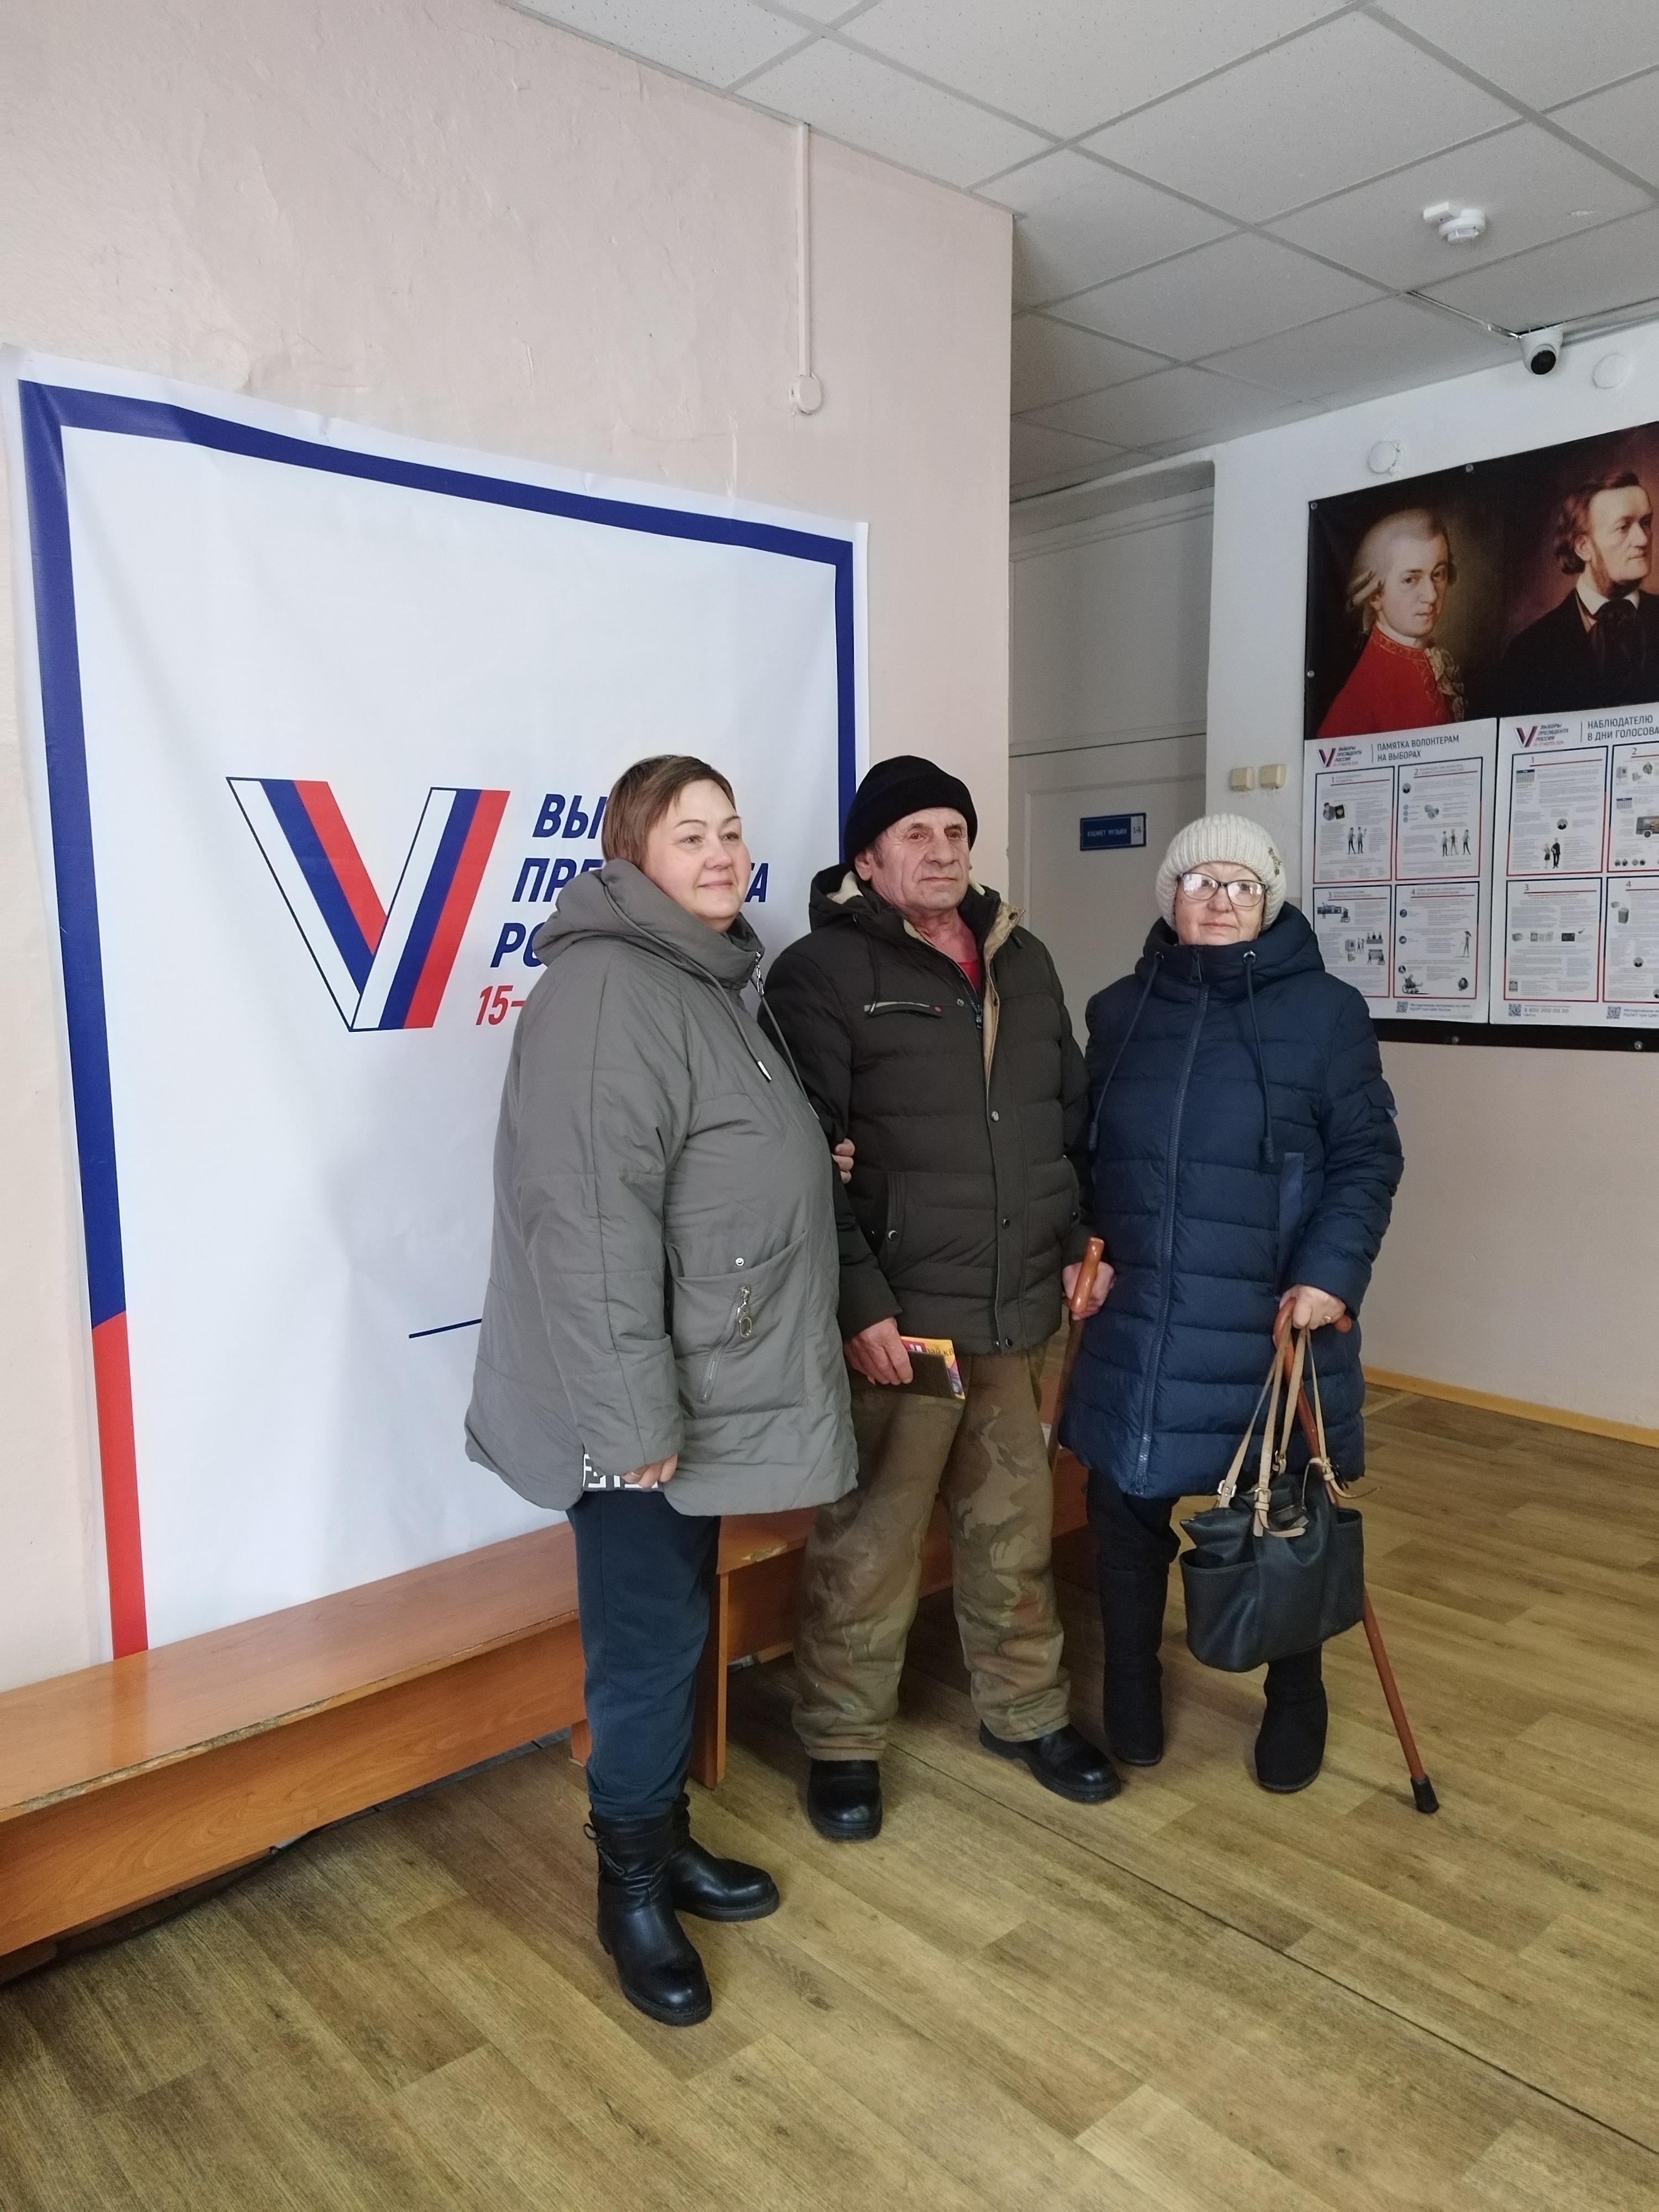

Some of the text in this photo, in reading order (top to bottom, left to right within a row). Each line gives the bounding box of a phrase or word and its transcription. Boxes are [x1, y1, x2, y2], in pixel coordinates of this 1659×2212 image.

[1588, 714, 1653, 729] НАБЛЮДАТЕЛЮ
[1377, 734, 1459, 752] ПАМЯТКА ВОЛОНТЕРАМ
[1595, 731, 1613, 742] ДНИ
[1378, 750, 1421, 762] НА ВЫБОРАХ
